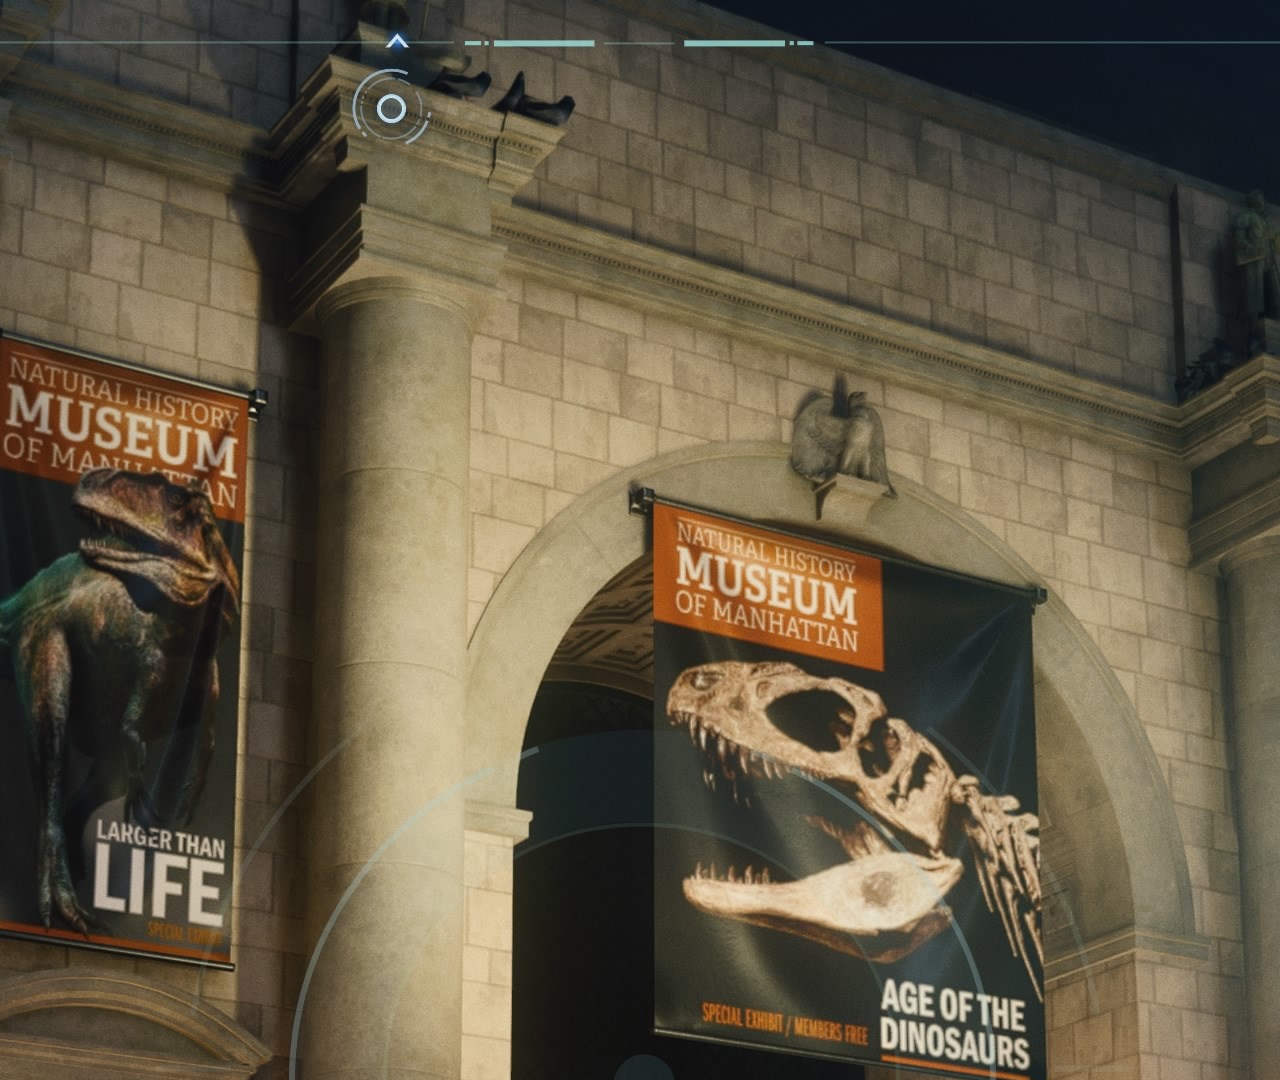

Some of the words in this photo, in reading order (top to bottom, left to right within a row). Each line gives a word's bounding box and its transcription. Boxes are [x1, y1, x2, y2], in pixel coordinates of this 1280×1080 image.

[10, 357, 128, 405] NATURAL
[135, 387, 239, 432] HISTORY
[3, 433, 44, 463] OF
[5, 383, 239, 479] MUSEUM
[677, 521, 770, 563] NATURAL
[774, 547, 856, 583] HISTORY
[676, 545, 857, 625] MUSEUM
[676, 590, 707, 617] OF
[712, 597, 859, 652] MANHATTAN
[97, 819, 172, 851] LARGER
[175, 831, 225, 859] THAN
[94, 842, 225, 928] LIFE
[702, 1001, 743, 1026] SPECIAL
[746, 1008, 784, 1033] EXHIBIT
[793, 1016, 842, 1041] MEMBERS
[845, 1023, 869, 1046] FREE
[881, 978, 935, 1018] AGE
[939, 987, 974, 1023] OF
[976, 993, 1026, 1032] THE
[880, 1016, 1031, 1071] DINOSAURS
